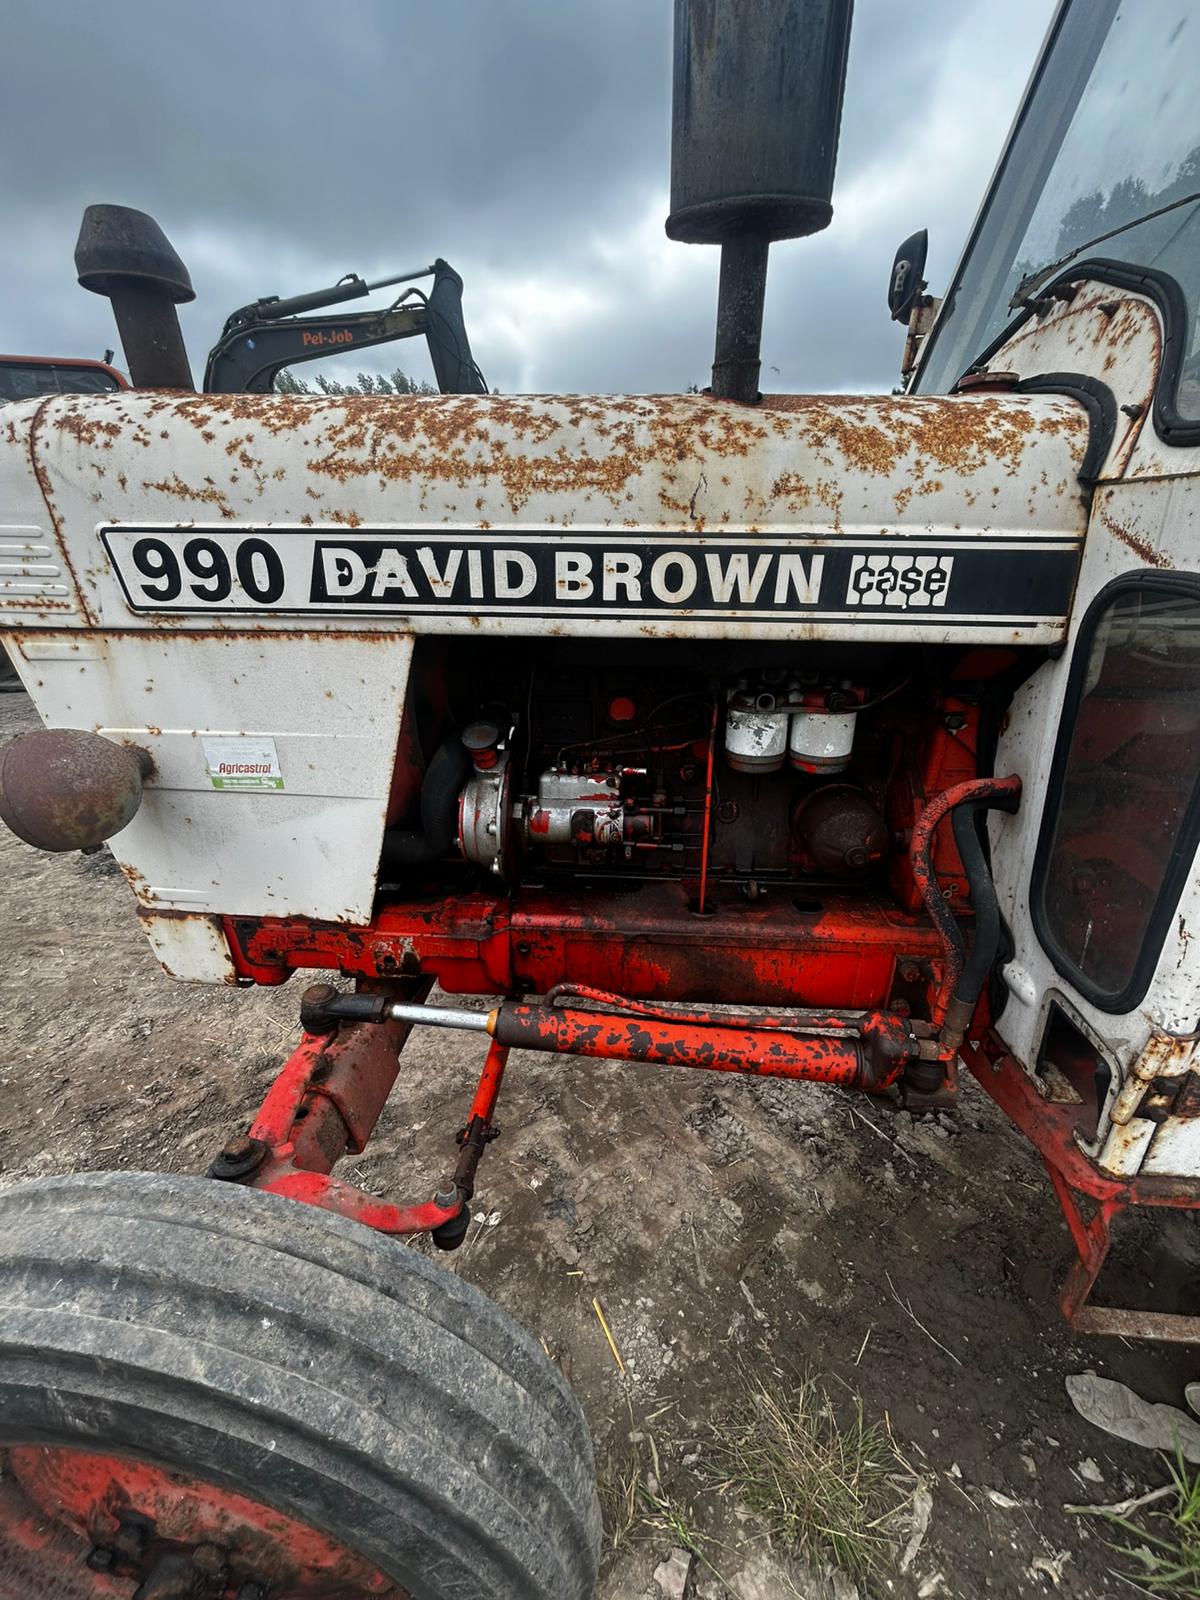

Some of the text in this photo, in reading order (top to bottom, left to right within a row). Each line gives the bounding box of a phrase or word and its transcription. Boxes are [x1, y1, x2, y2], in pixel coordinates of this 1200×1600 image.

[302, 329, 353, 346] Pel-Job
[132, 538, 285, 604] 990
[321, 546, 825, 604] DAVID BROWN
[852, 556, 948, 605] case
[218, 762, 272, 775] Agricastrol
